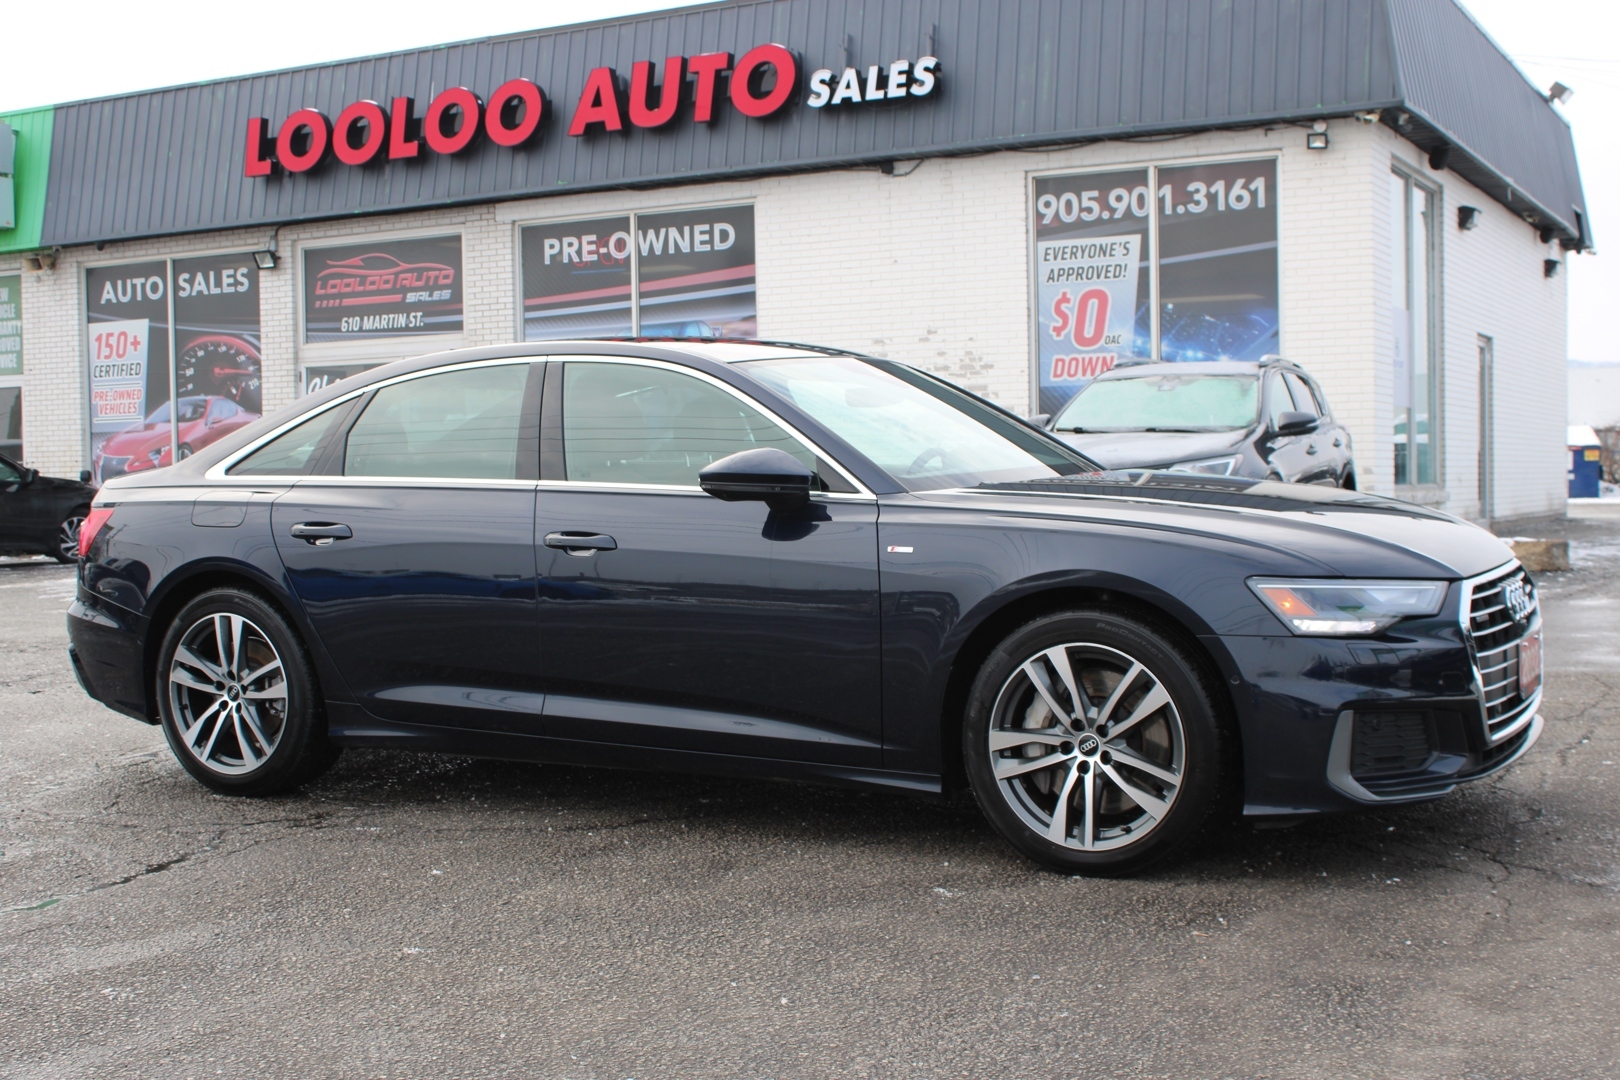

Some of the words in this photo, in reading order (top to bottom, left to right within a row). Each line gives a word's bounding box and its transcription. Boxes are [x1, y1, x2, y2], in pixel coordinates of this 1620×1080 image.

[245, 78, 543, 178] LOOLOO
[567, 43, 797, 137] AUTO
[807, 56, 938, 108] SALES
[1037, 176, 1266, 225] 905.901.3161
[543, 222, 736, 265] PRE-OWNED
[1043, 241, 1131, 262] EVERYONE'S
[315, 274, 395, 295] LOOLOO
[396, 269, 455, 289] AUTO
[1046, 263, 1128, 283] APPROVED!
[100, 276, 164, 304] AUTO
[178, 267, 249, 297] SALES
[405, 289, 452, 303] SALES
[341, 316, 360, 332] 610
[362, 313, 407, 330] MARTIN
[409, 312, 424, 327] ST.
[1052, 288, 1110, 348] $0
[95, 331, 141, 360] 150+
[1104, 334, 1121, 345] OAC
[93, 362, 142, 379] CERTIFIED
[1052, 355, 1115, 379] DOWN
[93, 389, 143, 402] PRE-OWNED
[98, 402, 138, 416] VEHICLES
